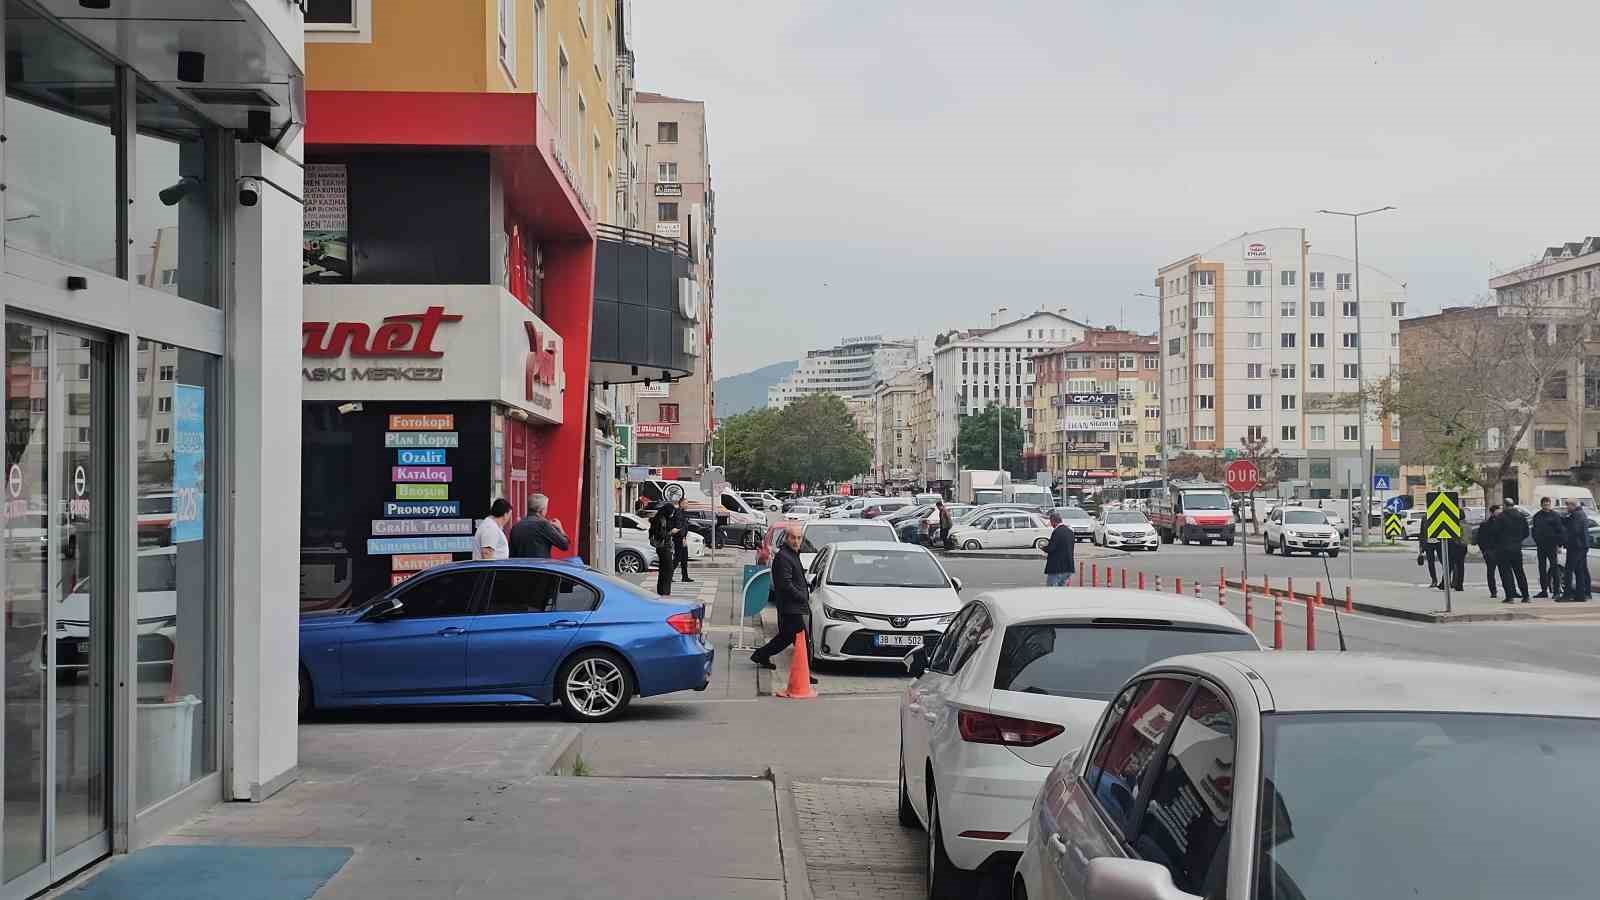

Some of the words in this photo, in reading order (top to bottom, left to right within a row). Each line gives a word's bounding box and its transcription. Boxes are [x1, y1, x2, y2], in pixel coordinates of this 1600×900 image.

[302, 305, 464, 358] anet
[302, 366, 346, 382] ASKI
[1228, 469, 1256, 482] DUR
[387, 502, 457, 517] Promosyon
